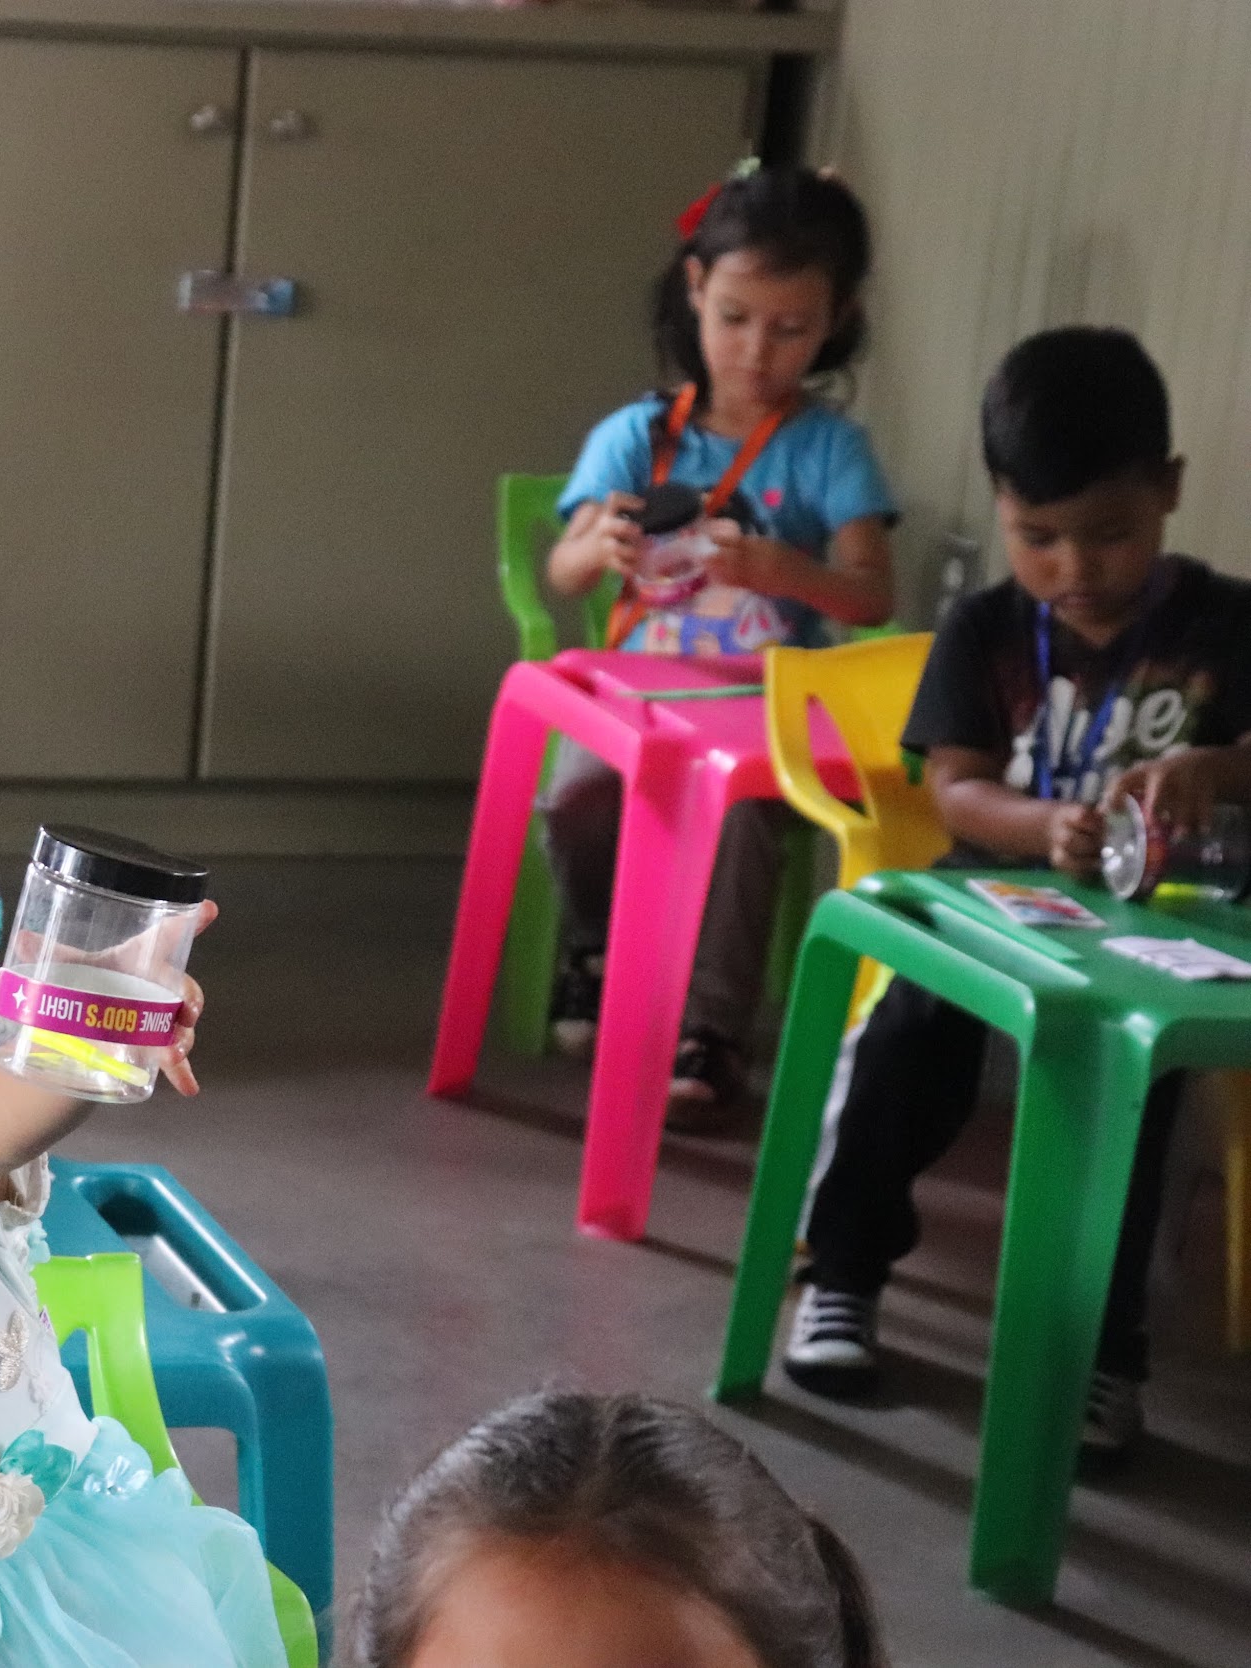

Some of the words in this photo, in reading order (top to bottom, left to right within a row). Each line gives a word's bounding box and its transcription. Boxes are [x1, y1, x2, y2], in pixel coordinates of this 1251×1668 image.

[37, 993, 84, 1023] LIGHT
[84, 1003, 138, 1033] GOD'S
[139, 1011, 173, 1033] SHINE
